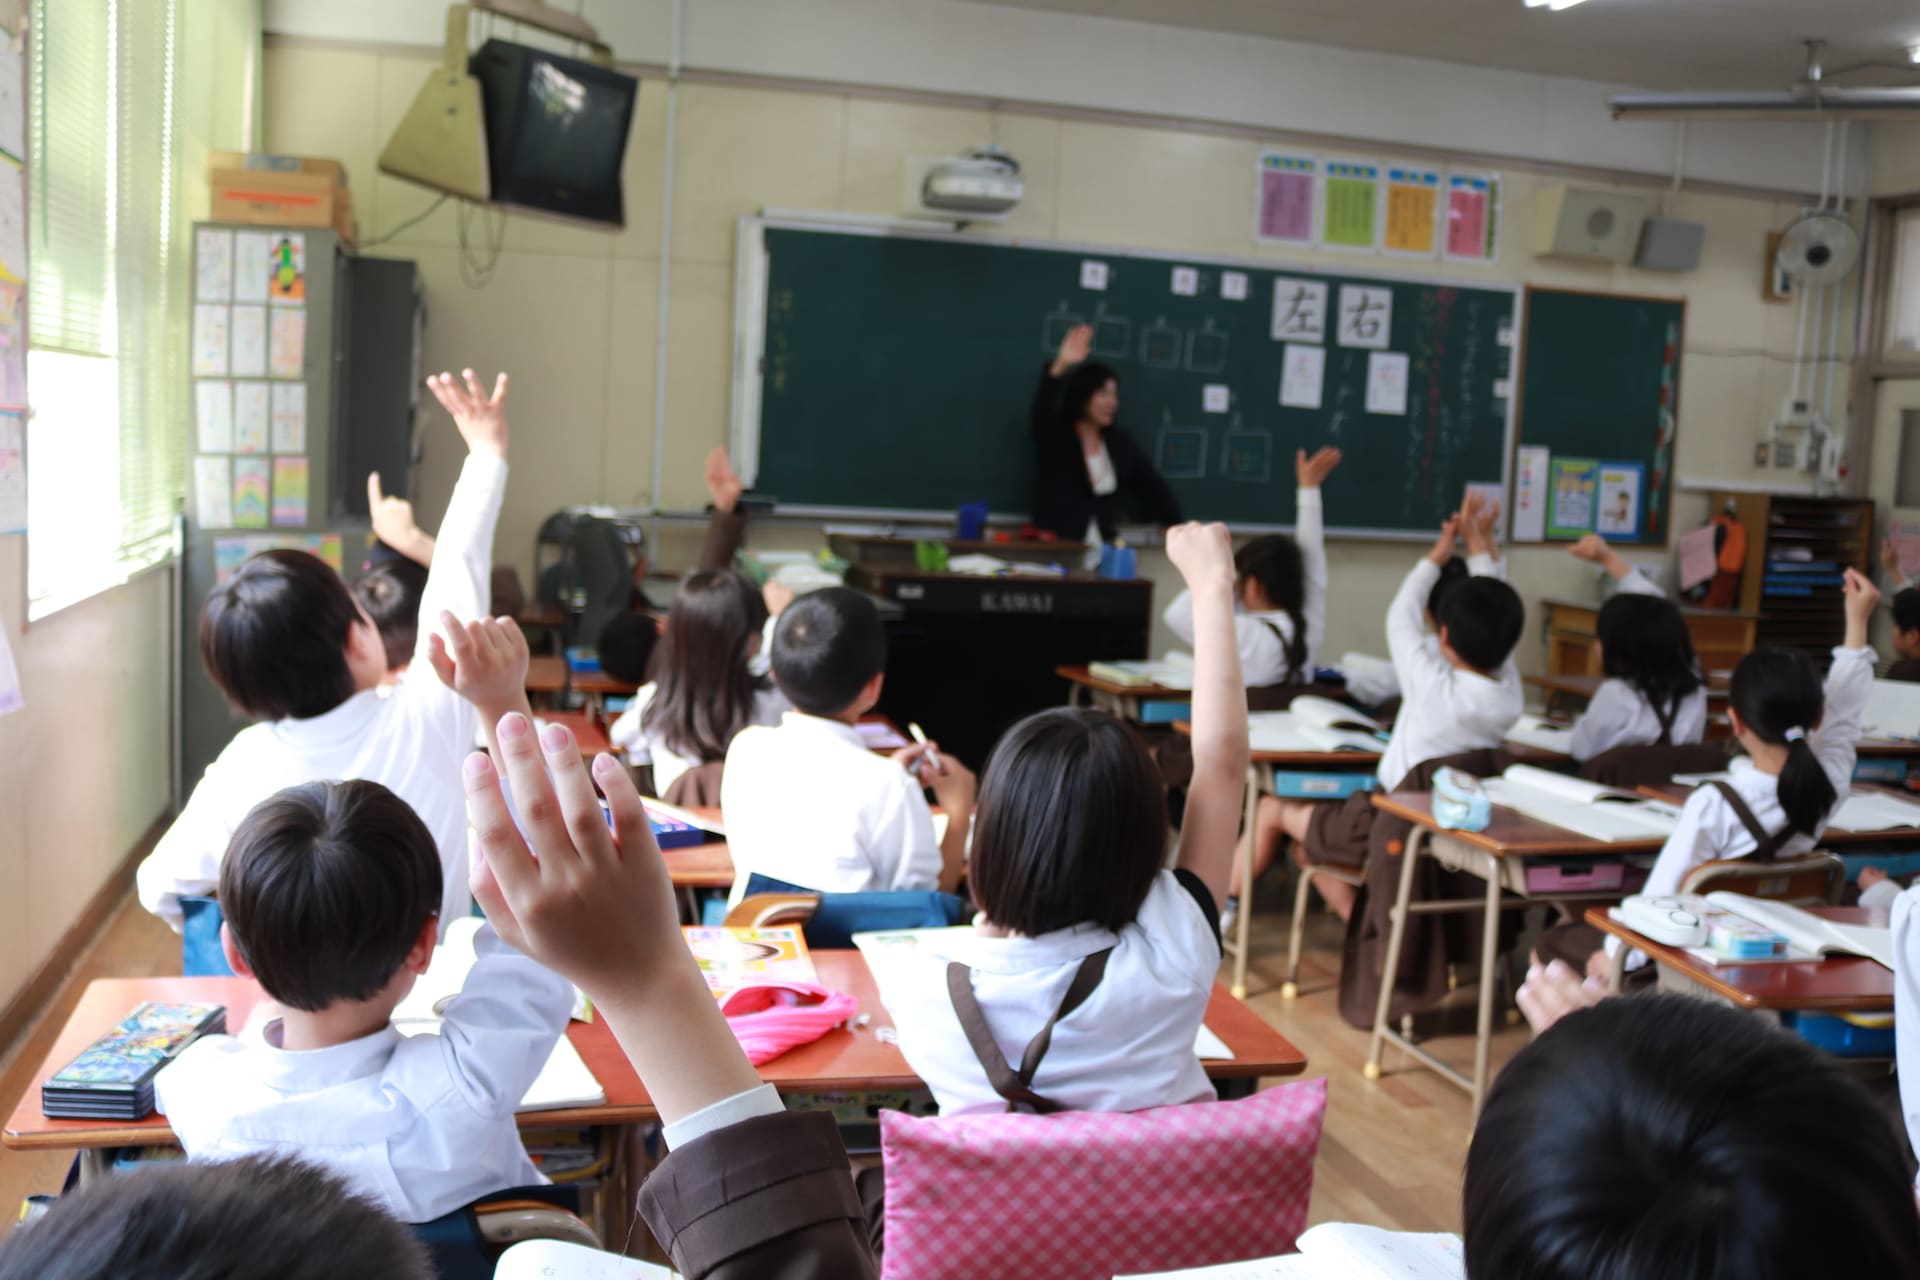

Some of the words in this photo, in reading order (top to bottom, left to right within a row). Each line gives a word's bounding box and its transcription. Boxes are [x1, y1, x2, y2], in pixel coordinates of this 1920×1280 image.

[1279, 285, 1319, 333] 左
[1345, 291, 1386, 338] 右
[981, 592, 1053, 612] KAWAI
